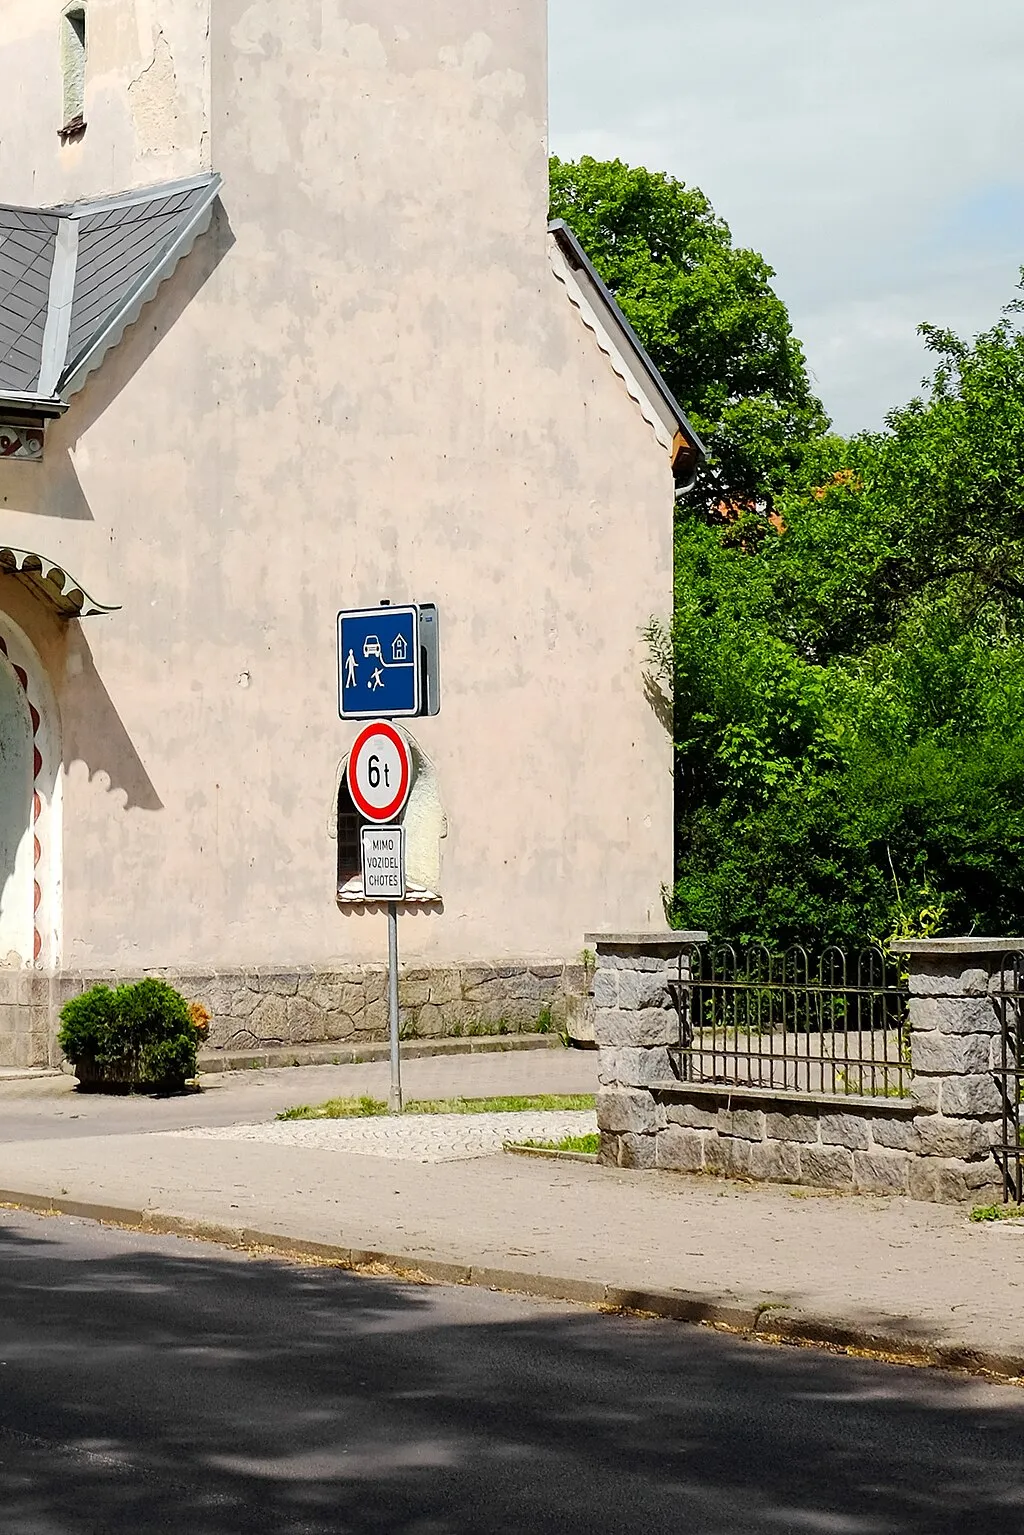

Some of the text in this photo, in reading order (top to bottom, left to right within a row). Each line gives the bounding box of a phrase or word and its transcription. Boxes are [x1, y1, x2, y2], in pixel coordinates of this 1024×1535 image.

[368, 754, 390, 788] 6 t
[372, 839, 394, 851] MIMO
[367, 857, 399, 869] VOZIDEL
[368, 874, 399, 887] CHOTES
